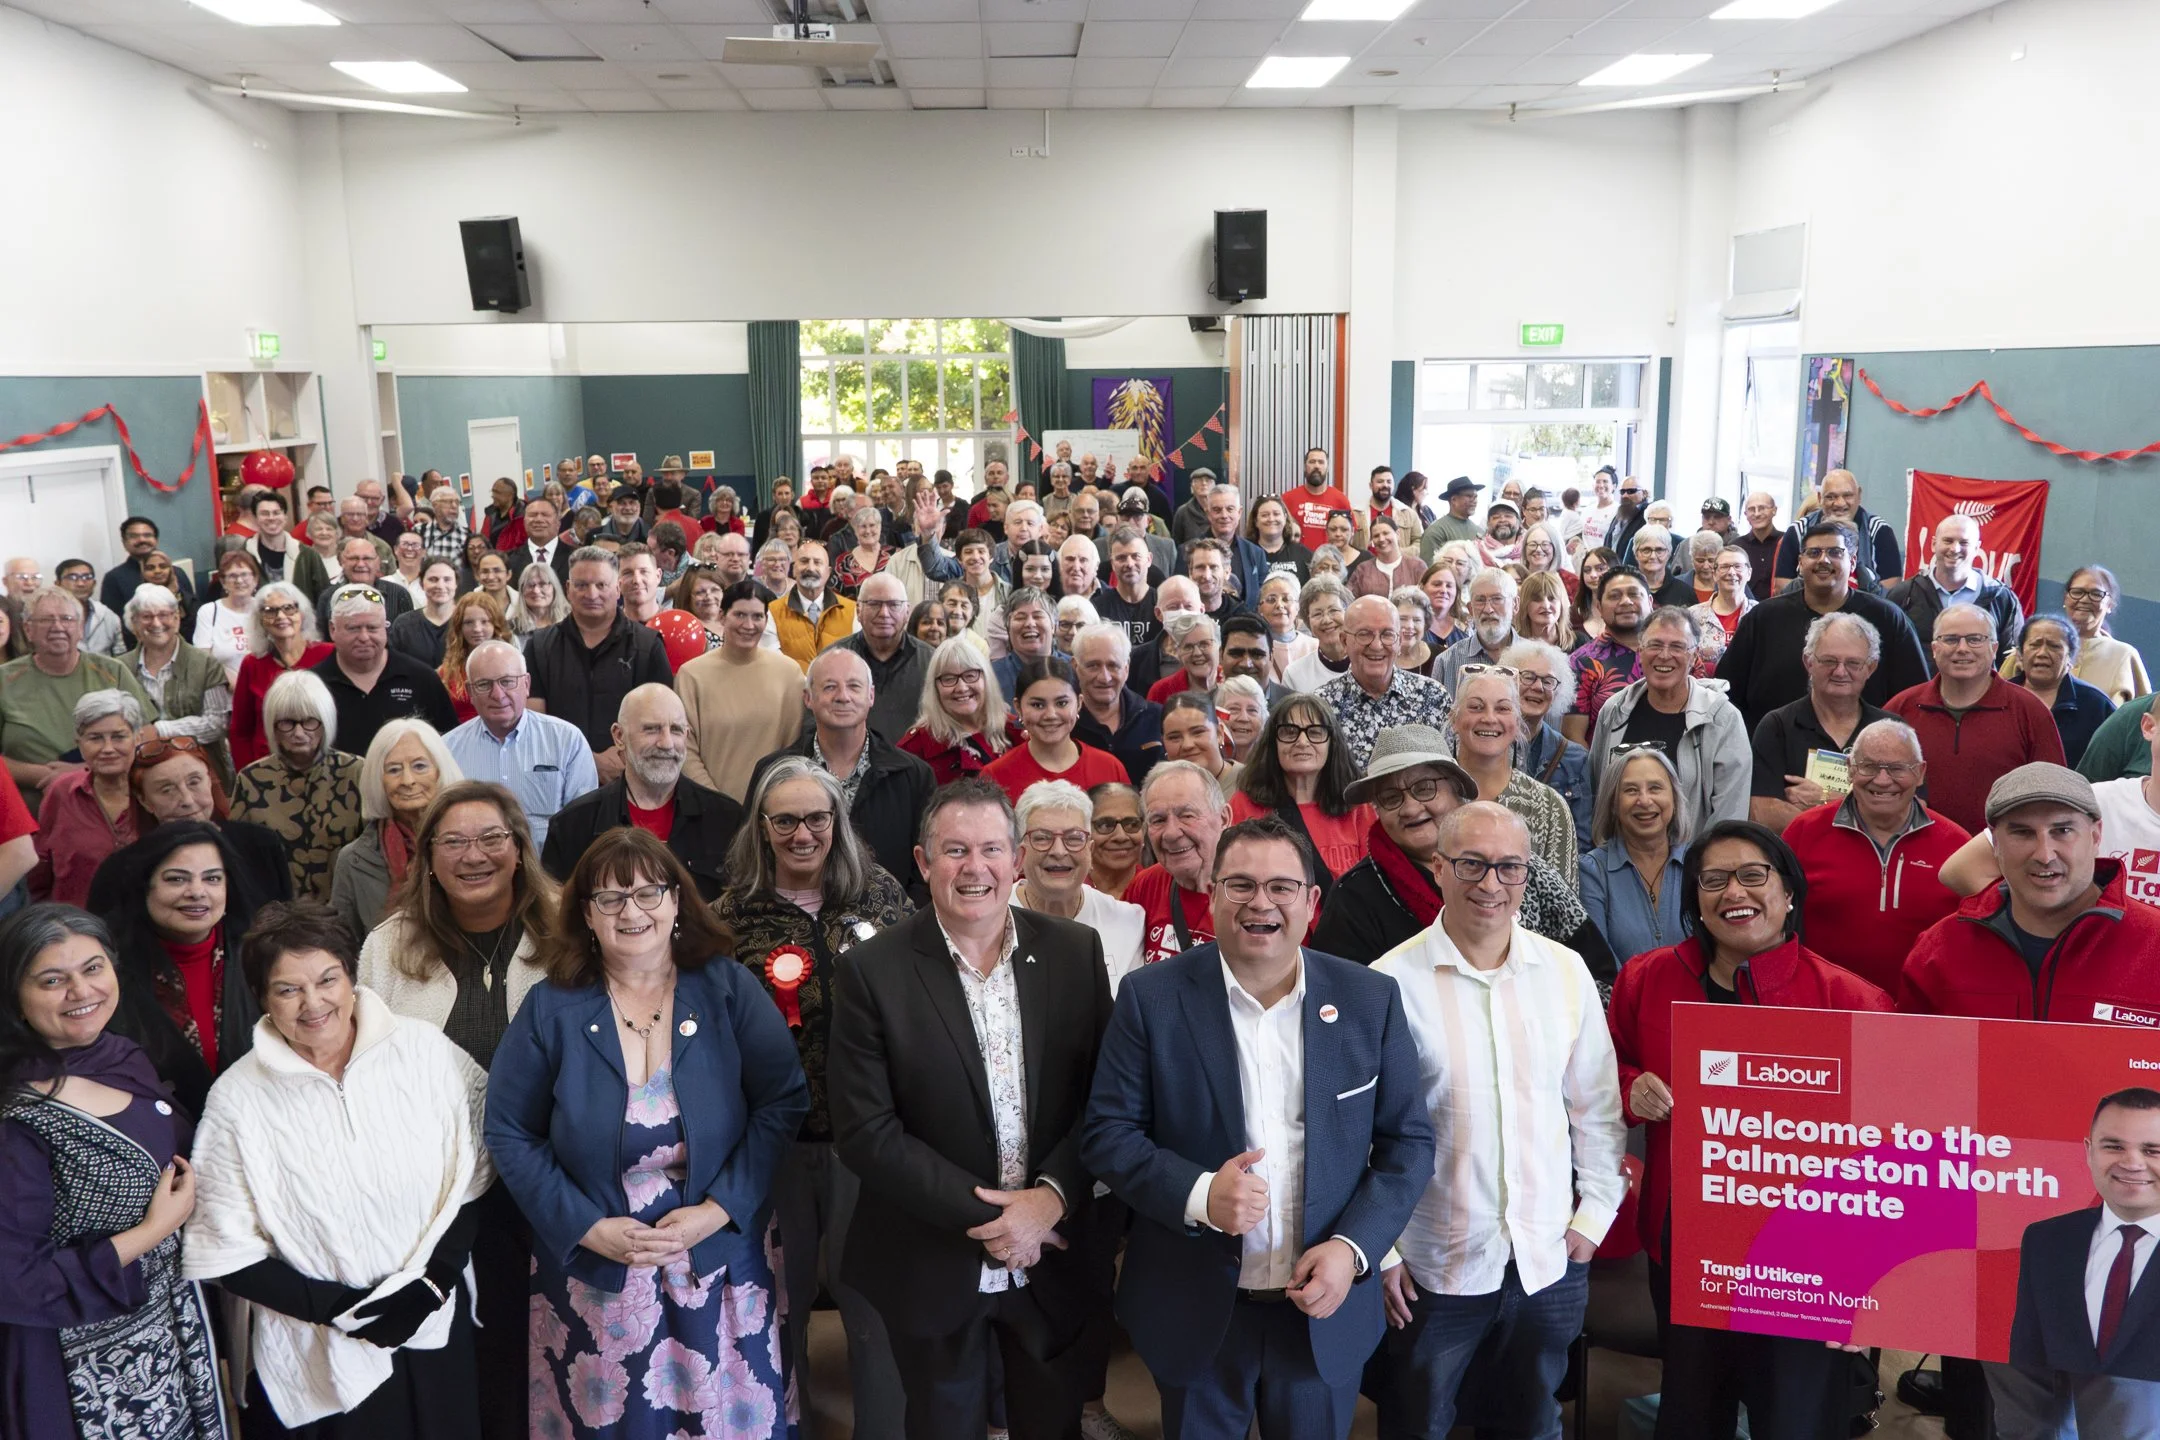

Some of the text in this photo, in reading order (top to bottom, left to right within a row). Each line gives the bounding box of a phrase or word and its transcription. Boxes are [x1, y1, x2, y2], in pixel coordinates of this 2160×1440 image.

[1529, 326, 1556, 342] EXIT
[1304, 516, 1327, 525] Utiker
[2115, 1009, 2157, 1026] Labour
[1746, 1061, 1831, 1086] Labour
[2129, 1058, 2160, 1071] labo
[1701, 1106, 2012, 1158] Welcome to the
[1702, 1140, 2059, 1199] Palmerston North
[1702, 1173, 1905, 1220] Electorate
[1700, 1259, 1824, 1286] Tangi Utikere
[1700, 1277, 1879, 1311] for Palmerston North
[1700, 1302, 1730, 1311] Authorised
[1781, 1311, 1799, 1319] Gilmer
